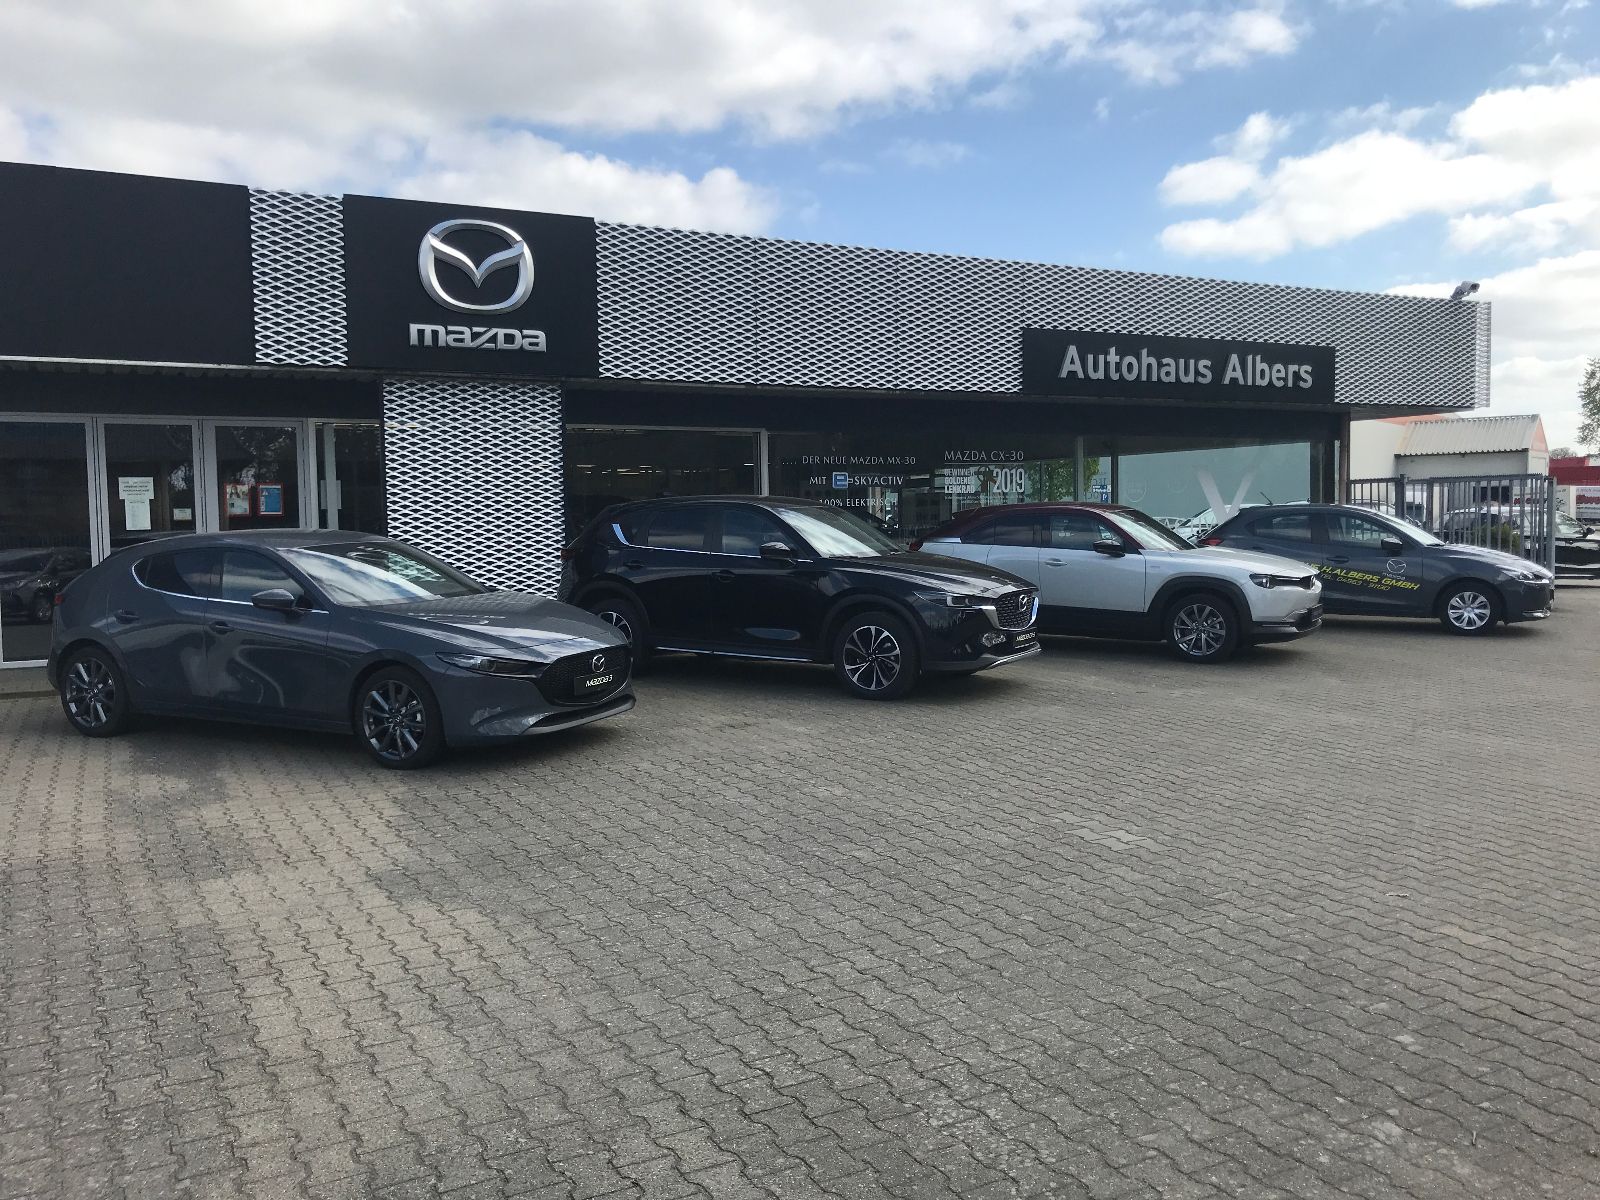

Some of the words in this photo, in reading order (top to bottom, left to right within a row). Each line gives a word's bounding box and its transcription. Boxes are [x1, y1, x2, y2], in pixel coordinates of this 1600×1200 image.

[1058, 344, 1213, 384] Autohaus
[1220, 353, 1313, 389] Albers
[802, 455, 820, 465] DER
[823, 455, 847, 465] NEUE
[849, 456, 885, 465] MAZDA
[886, 456, 916, 465] MX-30
[944, 450, 988, 462] MAZDA
[990, 450, 1025, 462] CX-30
[809, 476, 827, 485] MIT
[944, 476, 975, 485] GOLDENE
[992, 468, 1025, 493] 2019
[944, 485, 975, 494] LENKRAD
